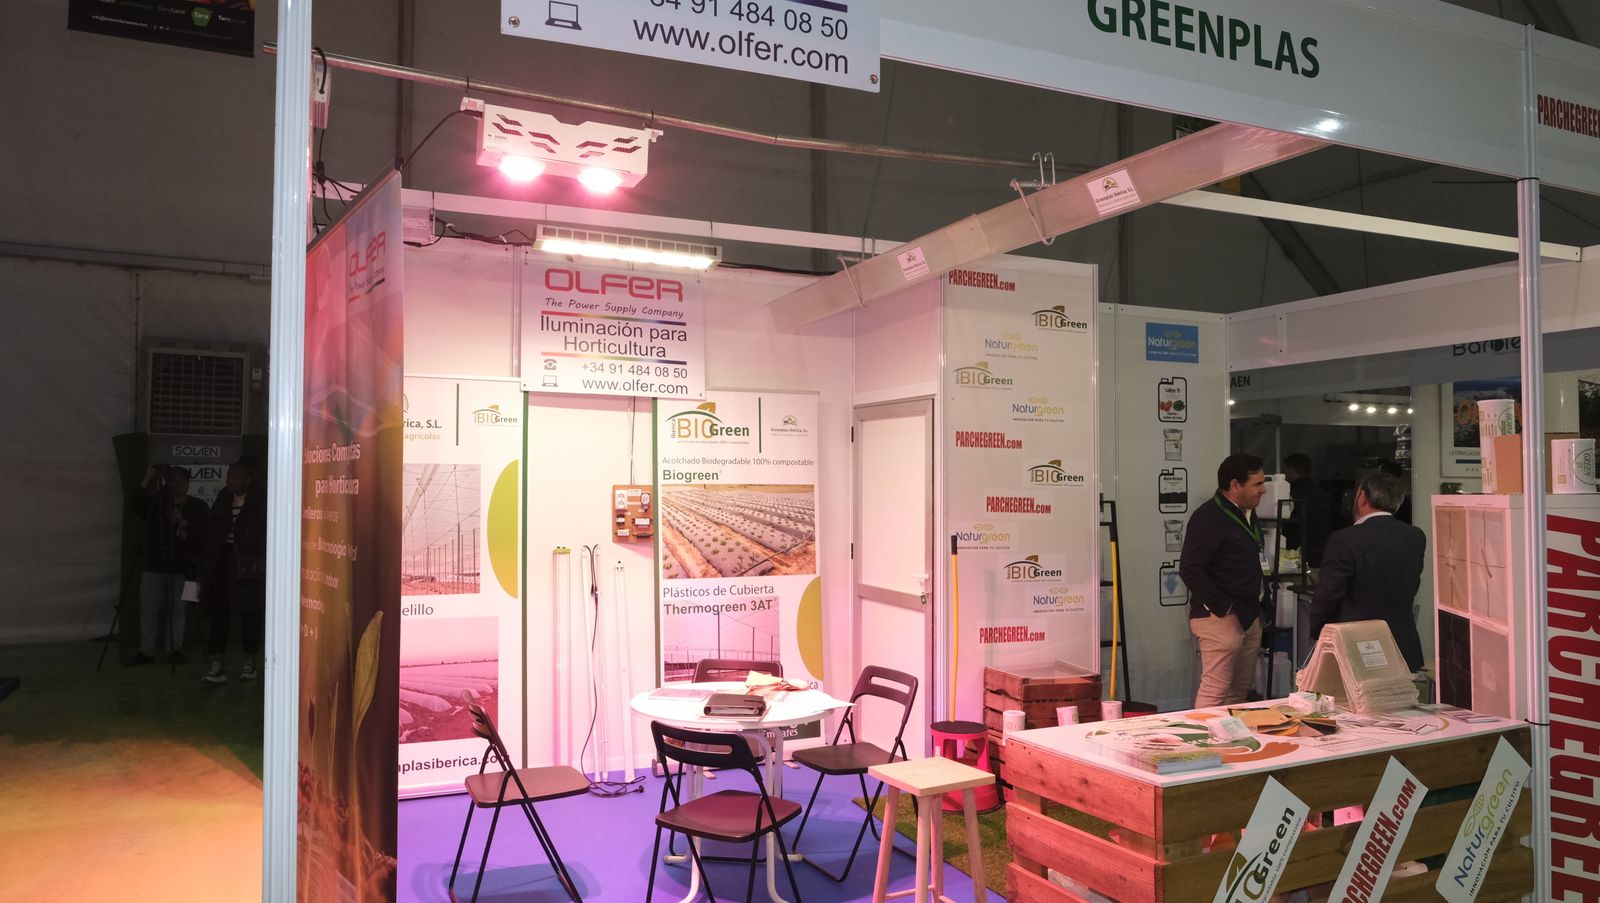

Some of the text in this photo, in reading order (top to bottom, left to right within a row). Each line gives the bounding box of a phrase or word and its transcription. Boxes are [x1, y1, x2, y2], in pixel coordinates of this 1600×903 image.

[729, 2, 775, 27] 484
[783, 9, 812, 34] 08
[821, 17, 848, 41] 50
[632, 19, 849, 75] www.olfer.com
[1087, 0, 1320, 79] GREENPLAS
[1537, 94, 1600, 139] PARCHEGREE
[545, 267, 684, 302] OLFER
[545, 297, 684, 319] The Power Supply Company
[540, 315, 687, 343] Iluminación para
[564, 336, 667, 358] Horticultura
[582, 362, 688, 379] +34 91 484 08 50
[582, 378, 689, 395] www.olfer.com
[662, 456, 814, 468] Acolchado Biodegradable 100% compostable
[663, 469, 719, 483] Biogreen
[956, 532, 1011, 544] Naturgreen
[663, 584, 774, 599] Plásticos de Cubierta
[1033, 594, 1085, 607] Naturgreen
[402, 603, 434, 617] elillo
[663, 599, 773, 616] Thermogreen 3AT
[1490, 826, 1502, 846] PARA
[1505, 780, 1520, 812] CULTIVO
[1454, 768, 1512, 888] Naturgreen
